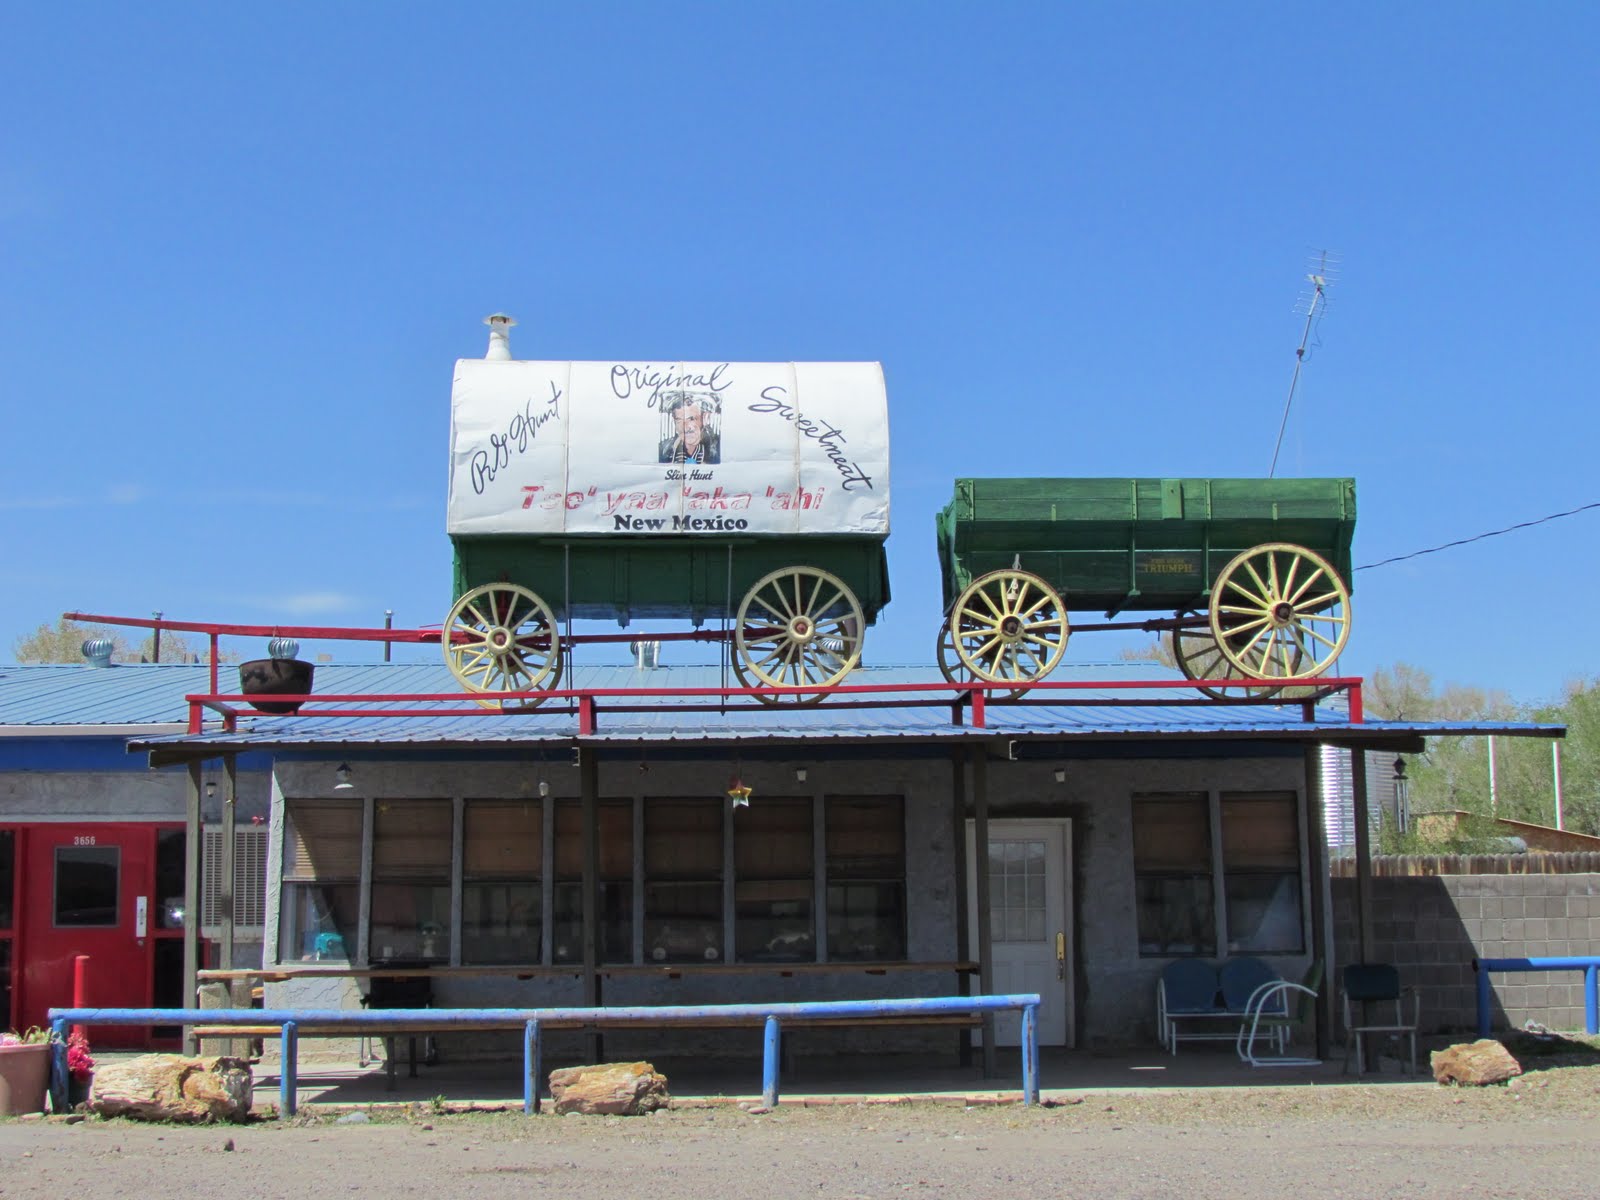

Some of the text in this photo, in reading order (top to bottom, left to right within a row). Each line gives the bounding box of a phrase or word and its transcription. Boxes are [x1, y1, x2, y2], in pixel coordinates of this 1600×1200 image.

[611, 363, 733, 407] Original
[748, 386, 873, 491] Sweetmeat
[665, 469, 713, 480] Slim Hunt
[613, 514, 748, 531] New Mexico
[1144, 563, 1192, 573] TRIUMPH
